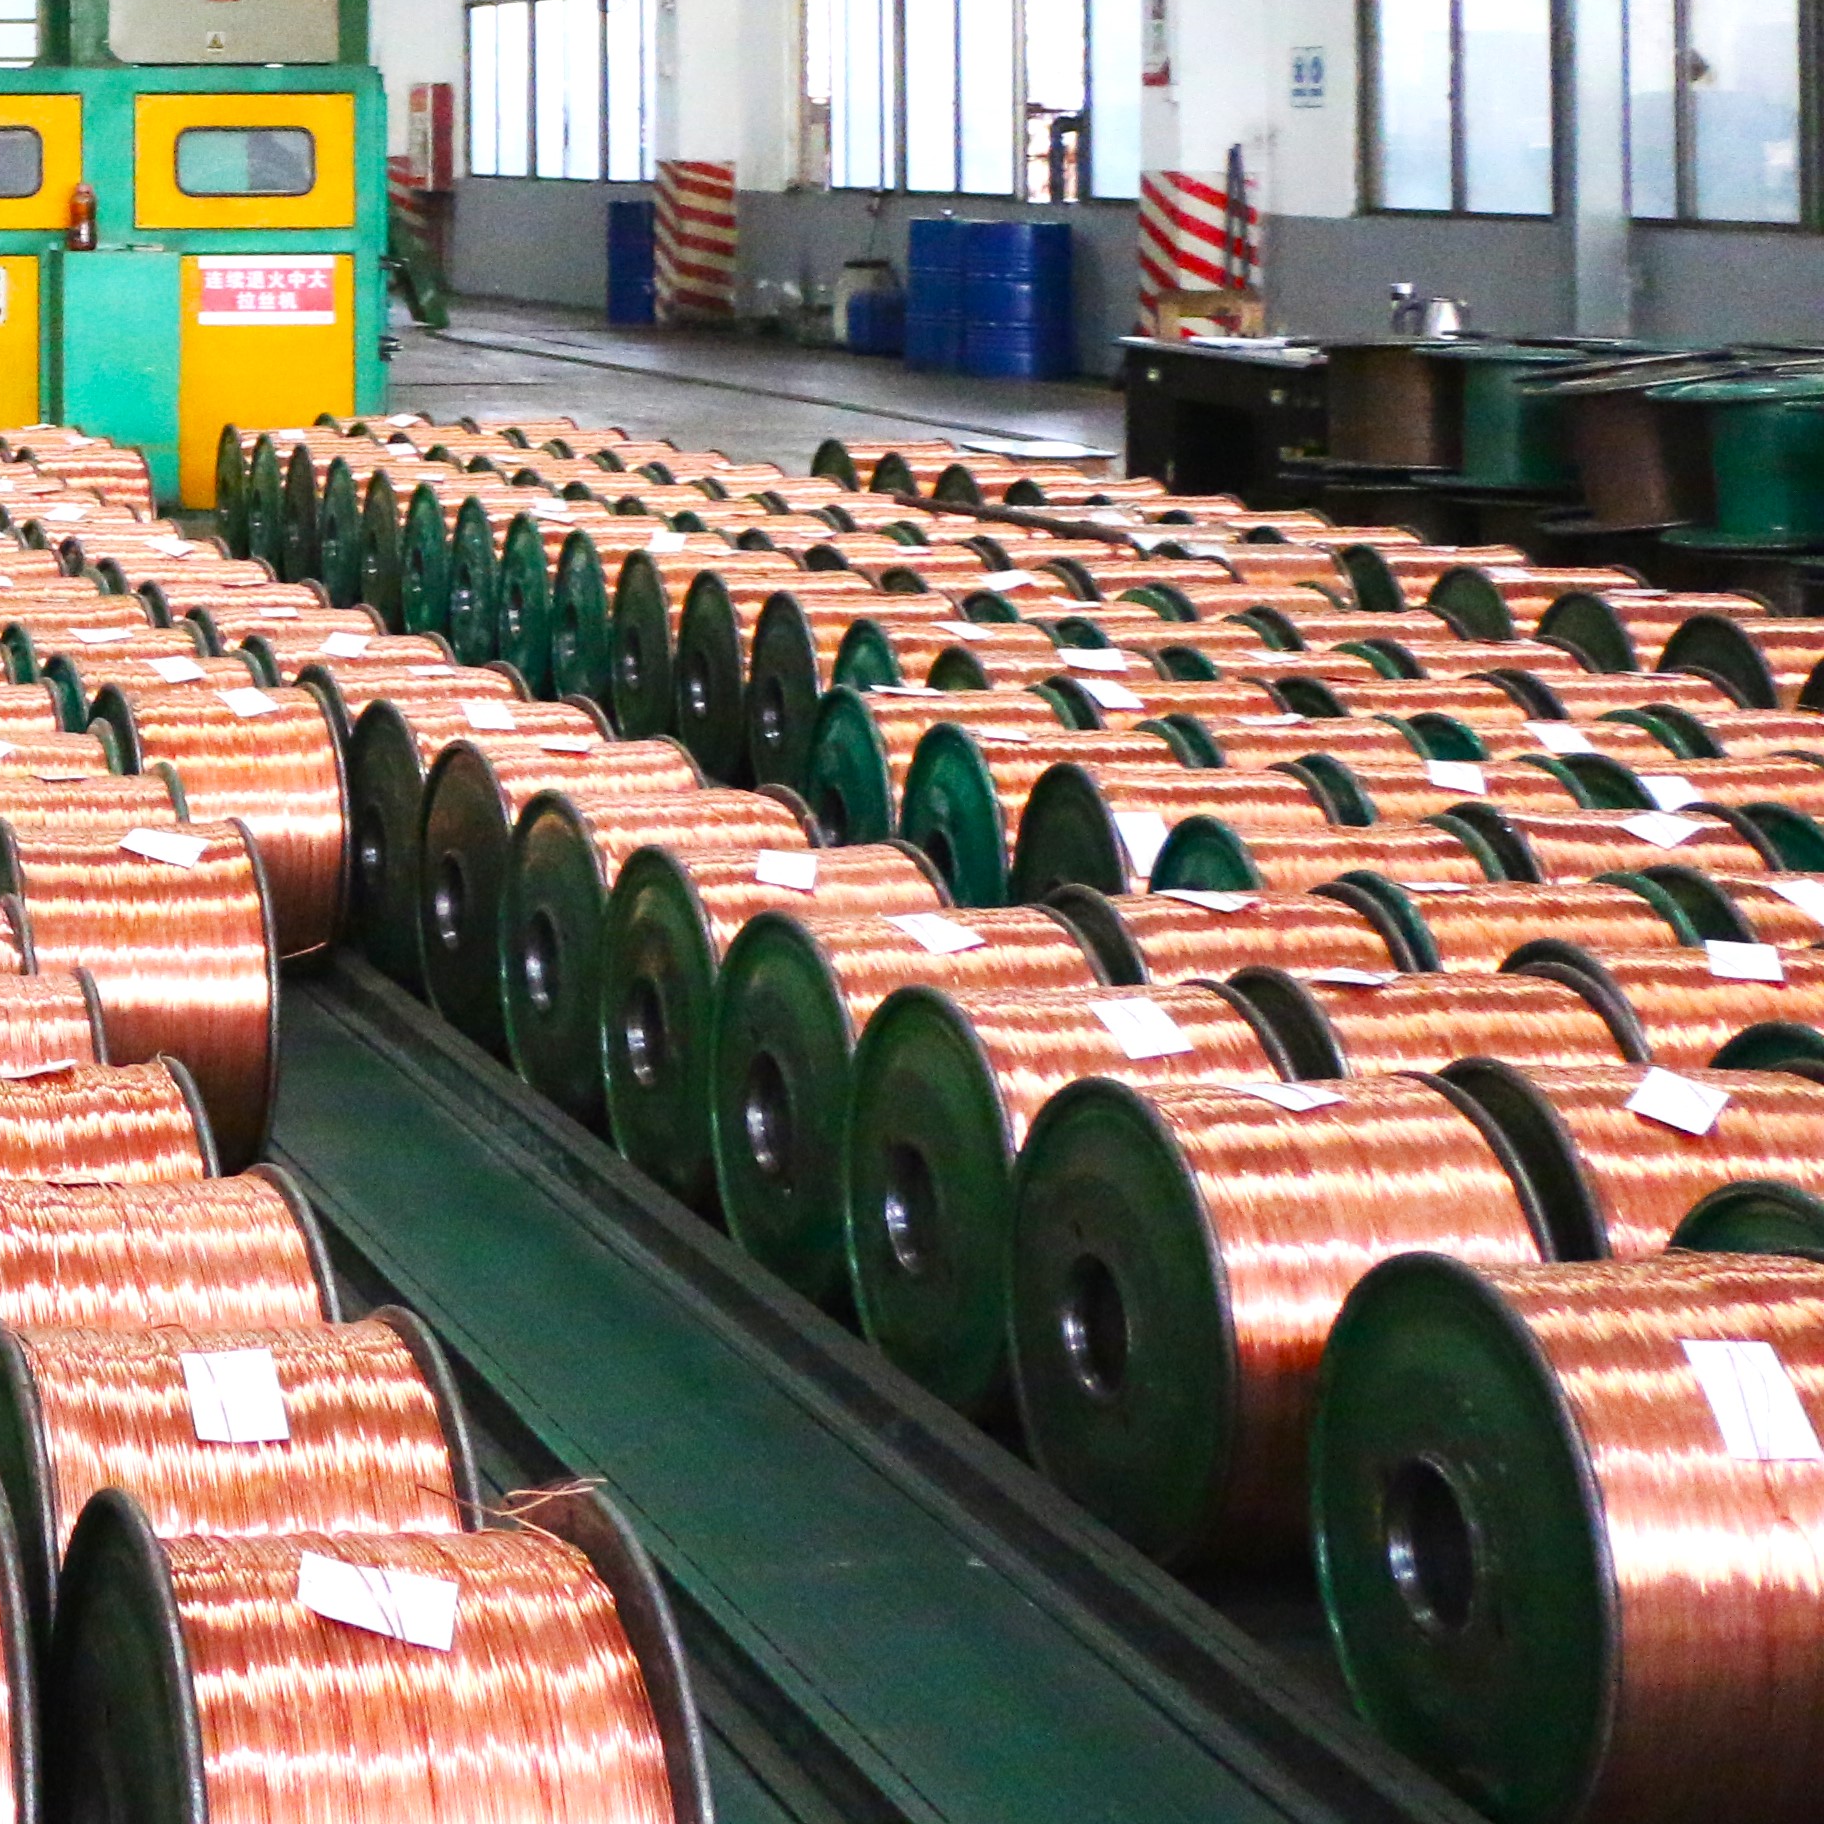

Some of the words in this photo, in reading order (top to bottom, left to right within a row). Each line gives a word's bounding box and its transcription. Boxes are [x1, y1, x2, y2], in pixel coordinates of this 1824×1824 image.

[204, 271, 328, 290] 连续退火中大
[236, 291, 298, 310] 拉丝机
